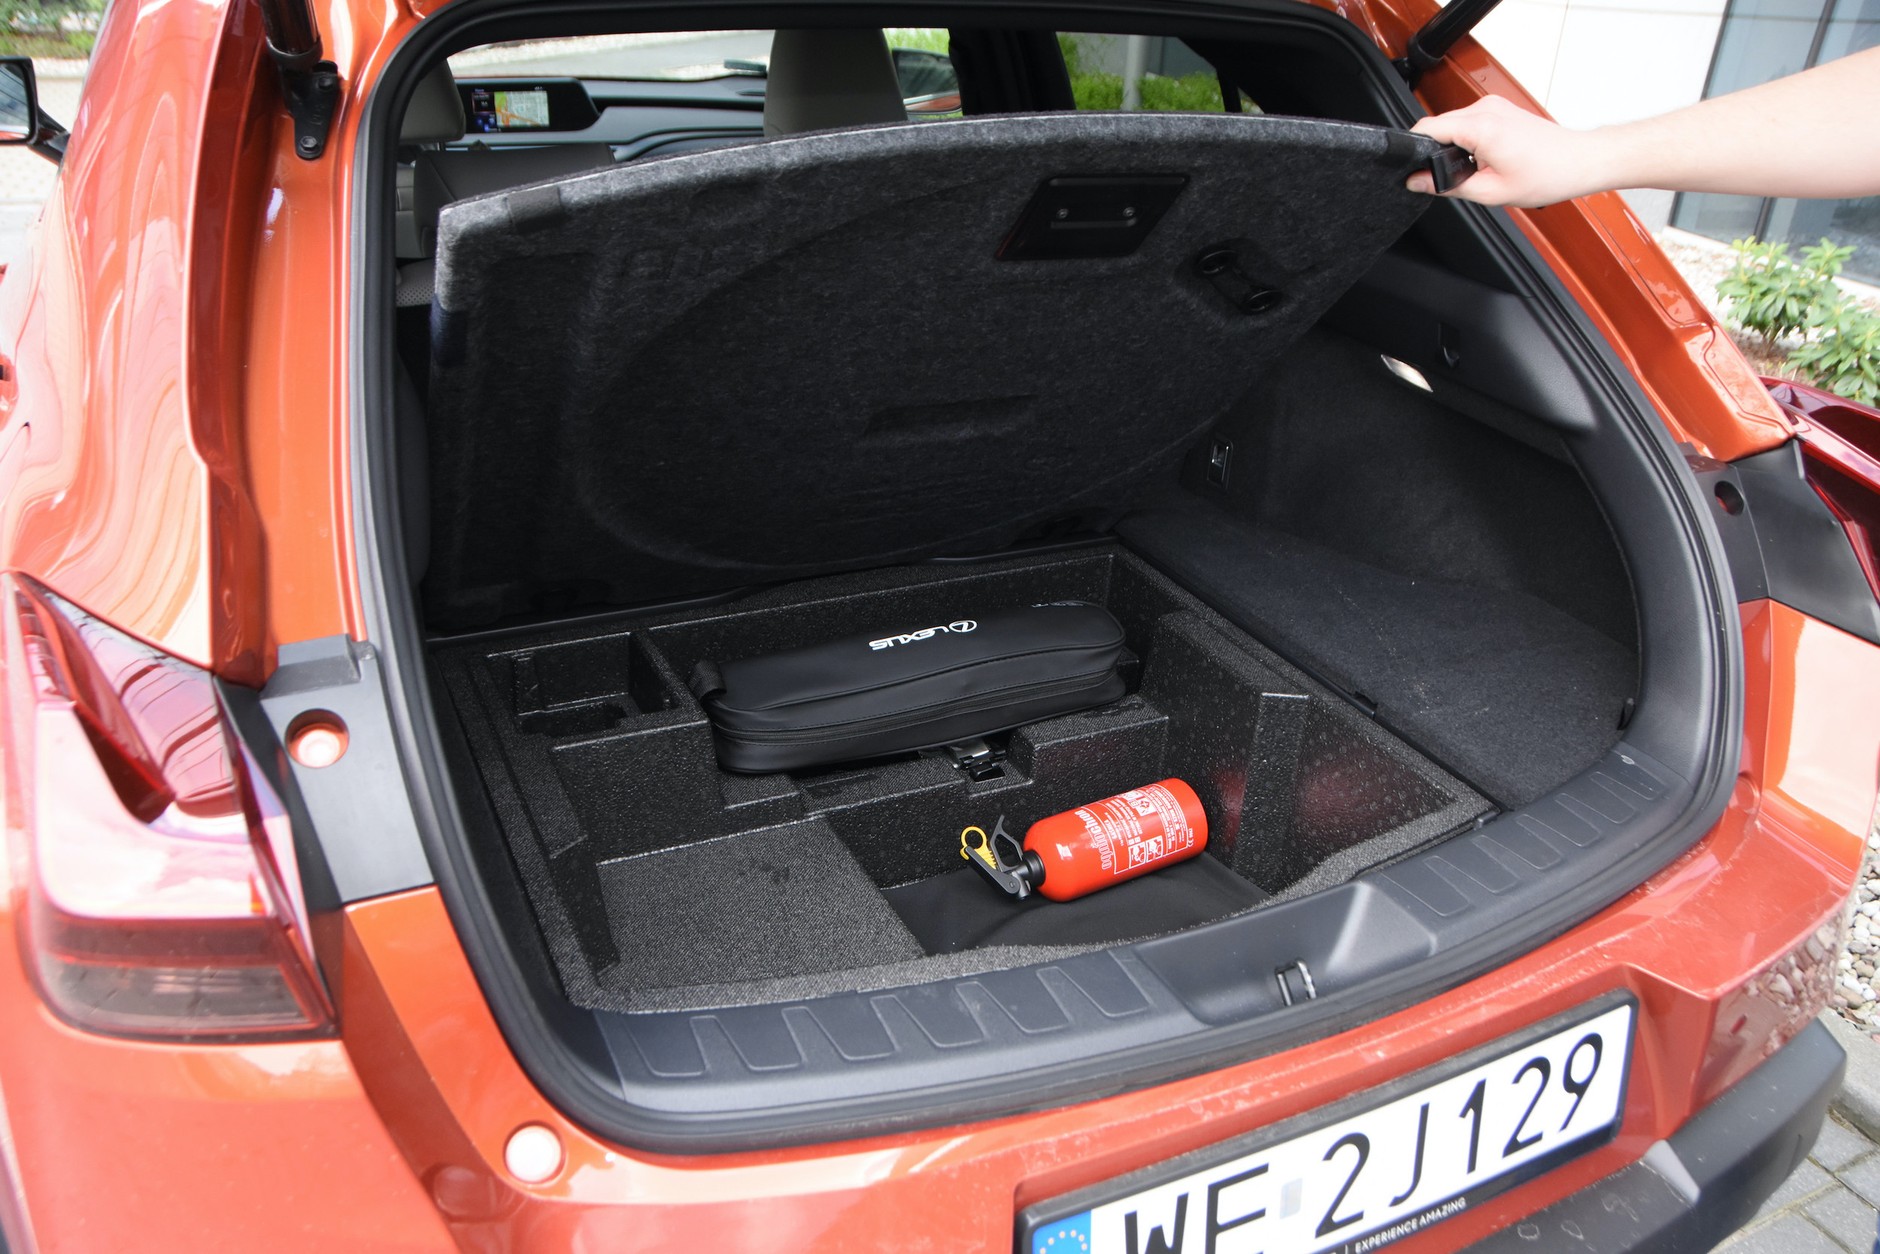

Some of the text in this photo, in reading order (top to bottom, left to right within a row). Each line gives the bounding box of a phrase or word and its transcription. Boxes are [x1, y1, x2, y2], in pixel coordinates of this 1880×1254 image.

[869, 626, 949, 650] LEXUS
[1124, 1032, 1603, 1254] WE 2J129
[1355, 1197, 1467, 1254] EXPERIENCE AMAZING
